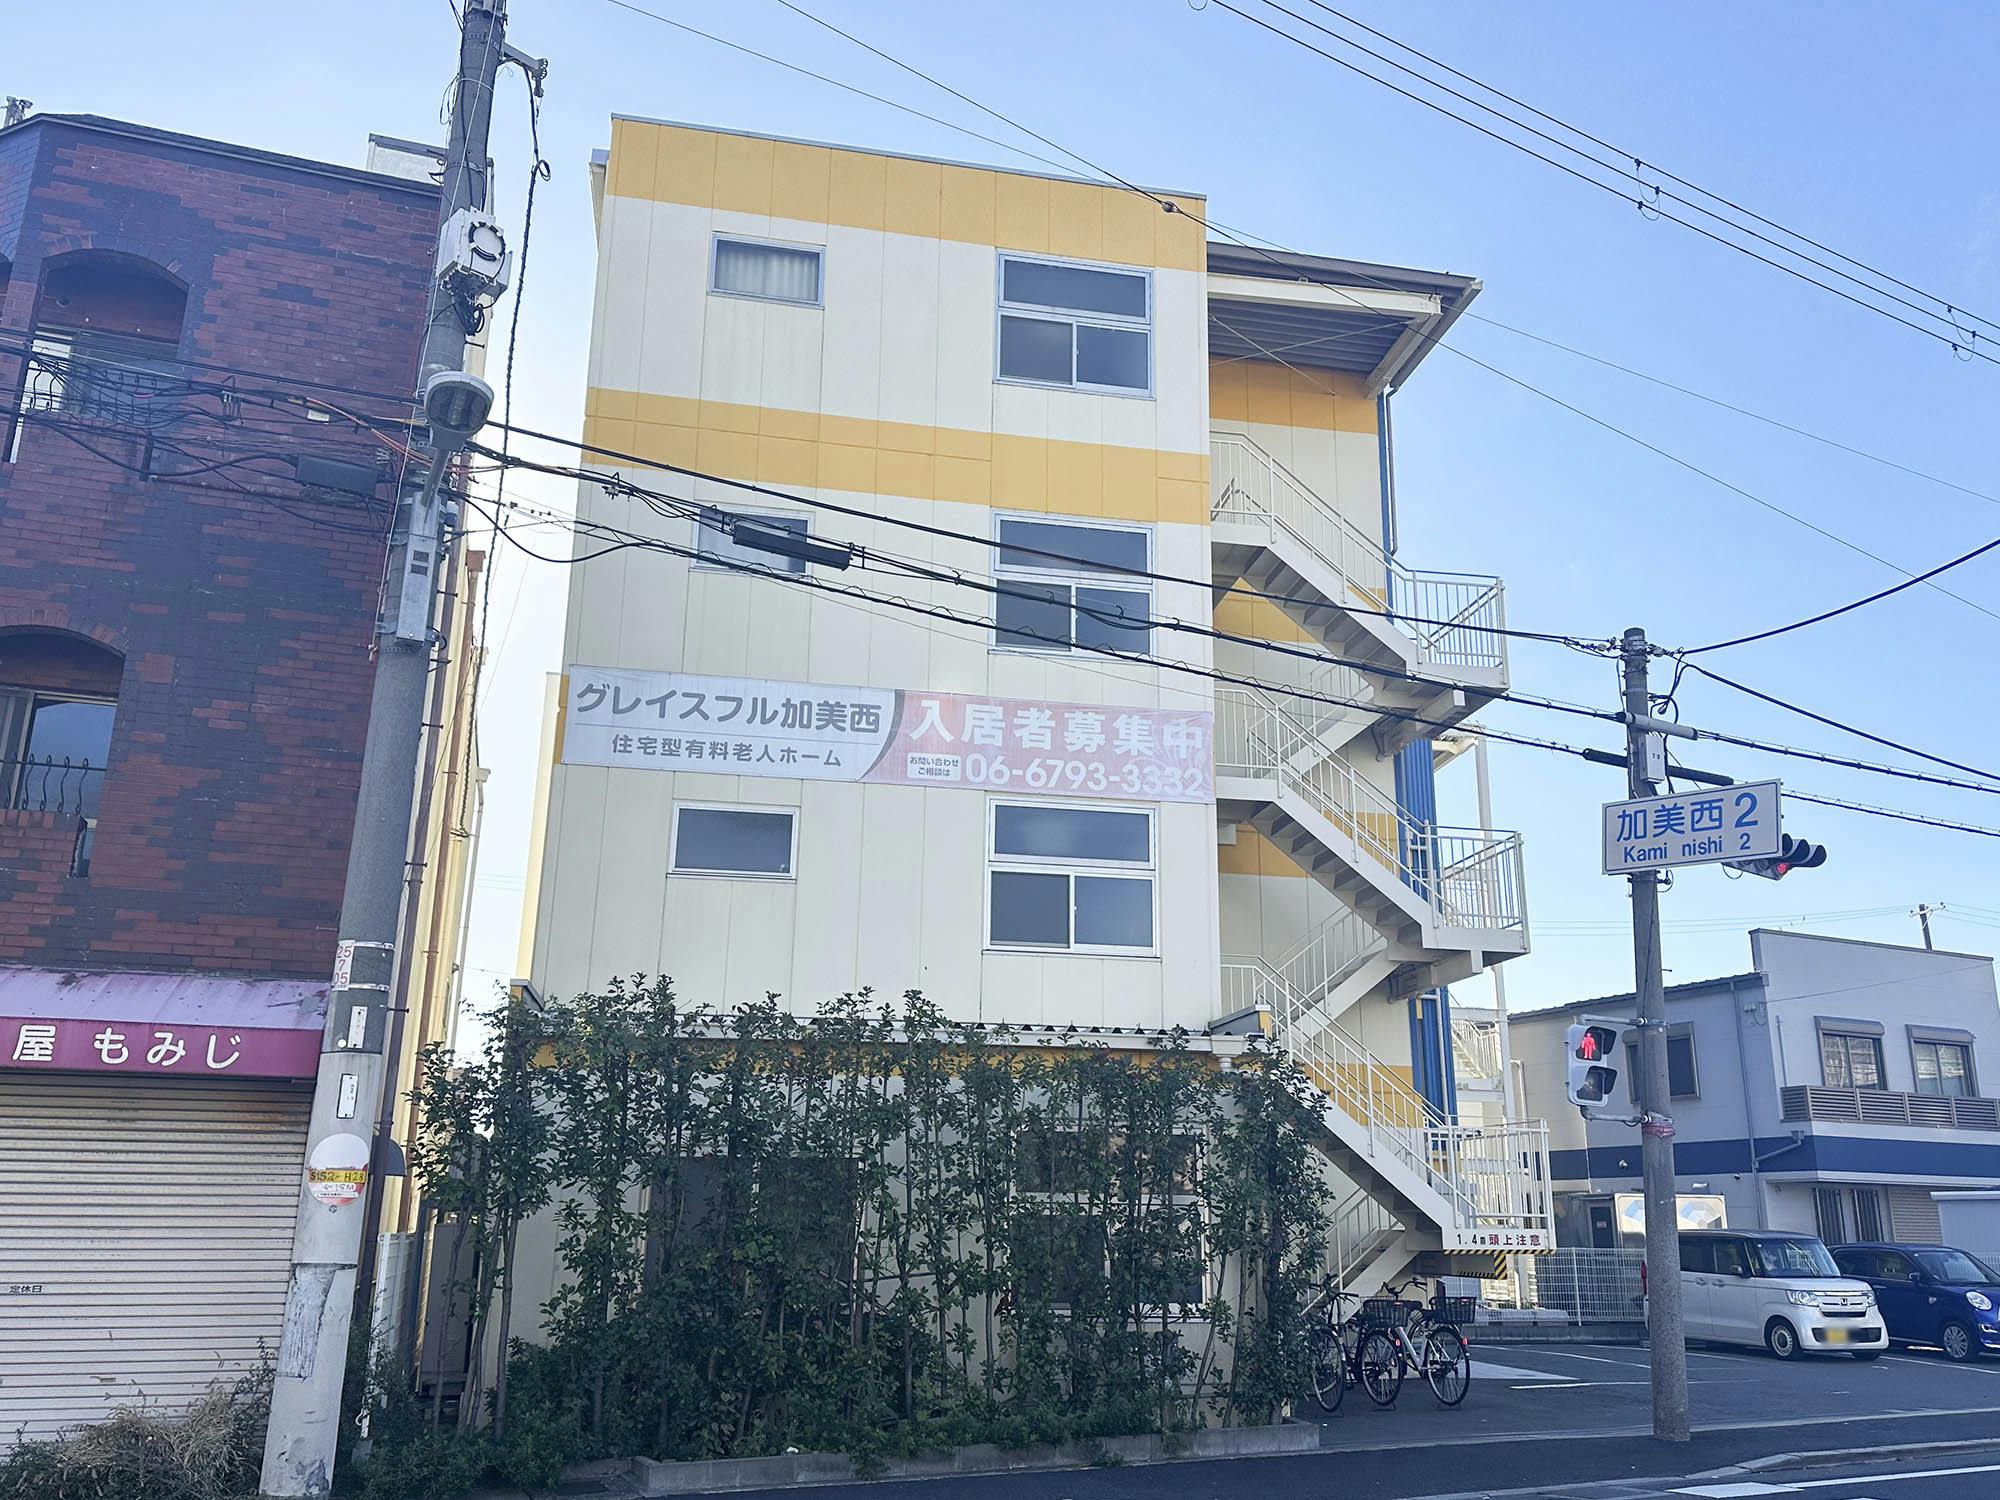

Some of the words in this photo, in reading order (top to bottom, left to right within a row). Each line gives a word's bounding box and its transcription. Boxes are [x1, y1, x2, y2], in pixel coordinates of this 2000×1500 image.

[576, 682, 882, 734] グレイスフル加美西
[909, 699, 1203, 758] 入居者募集中
[611, 733, 842, 767] 住宅型有料老人ホーム
[909, 756, 960, 768] お問い合わせ
[917, 767, 951, 777] ご相談は
[965, 752, 1204, 796] 06-6793-3332
[1616, 792, 1759, 843] 加美西2
[1623, 842, 1668, 863] Kami
[1682, 835, 1723, 857] nishi
[1739, 832, 1751, 850] 2
[12, 1024, 57, 1062] 屋
[93, 1026, 241, 1070] もみじ
[9, 1285, 43, 1294] 定休日
